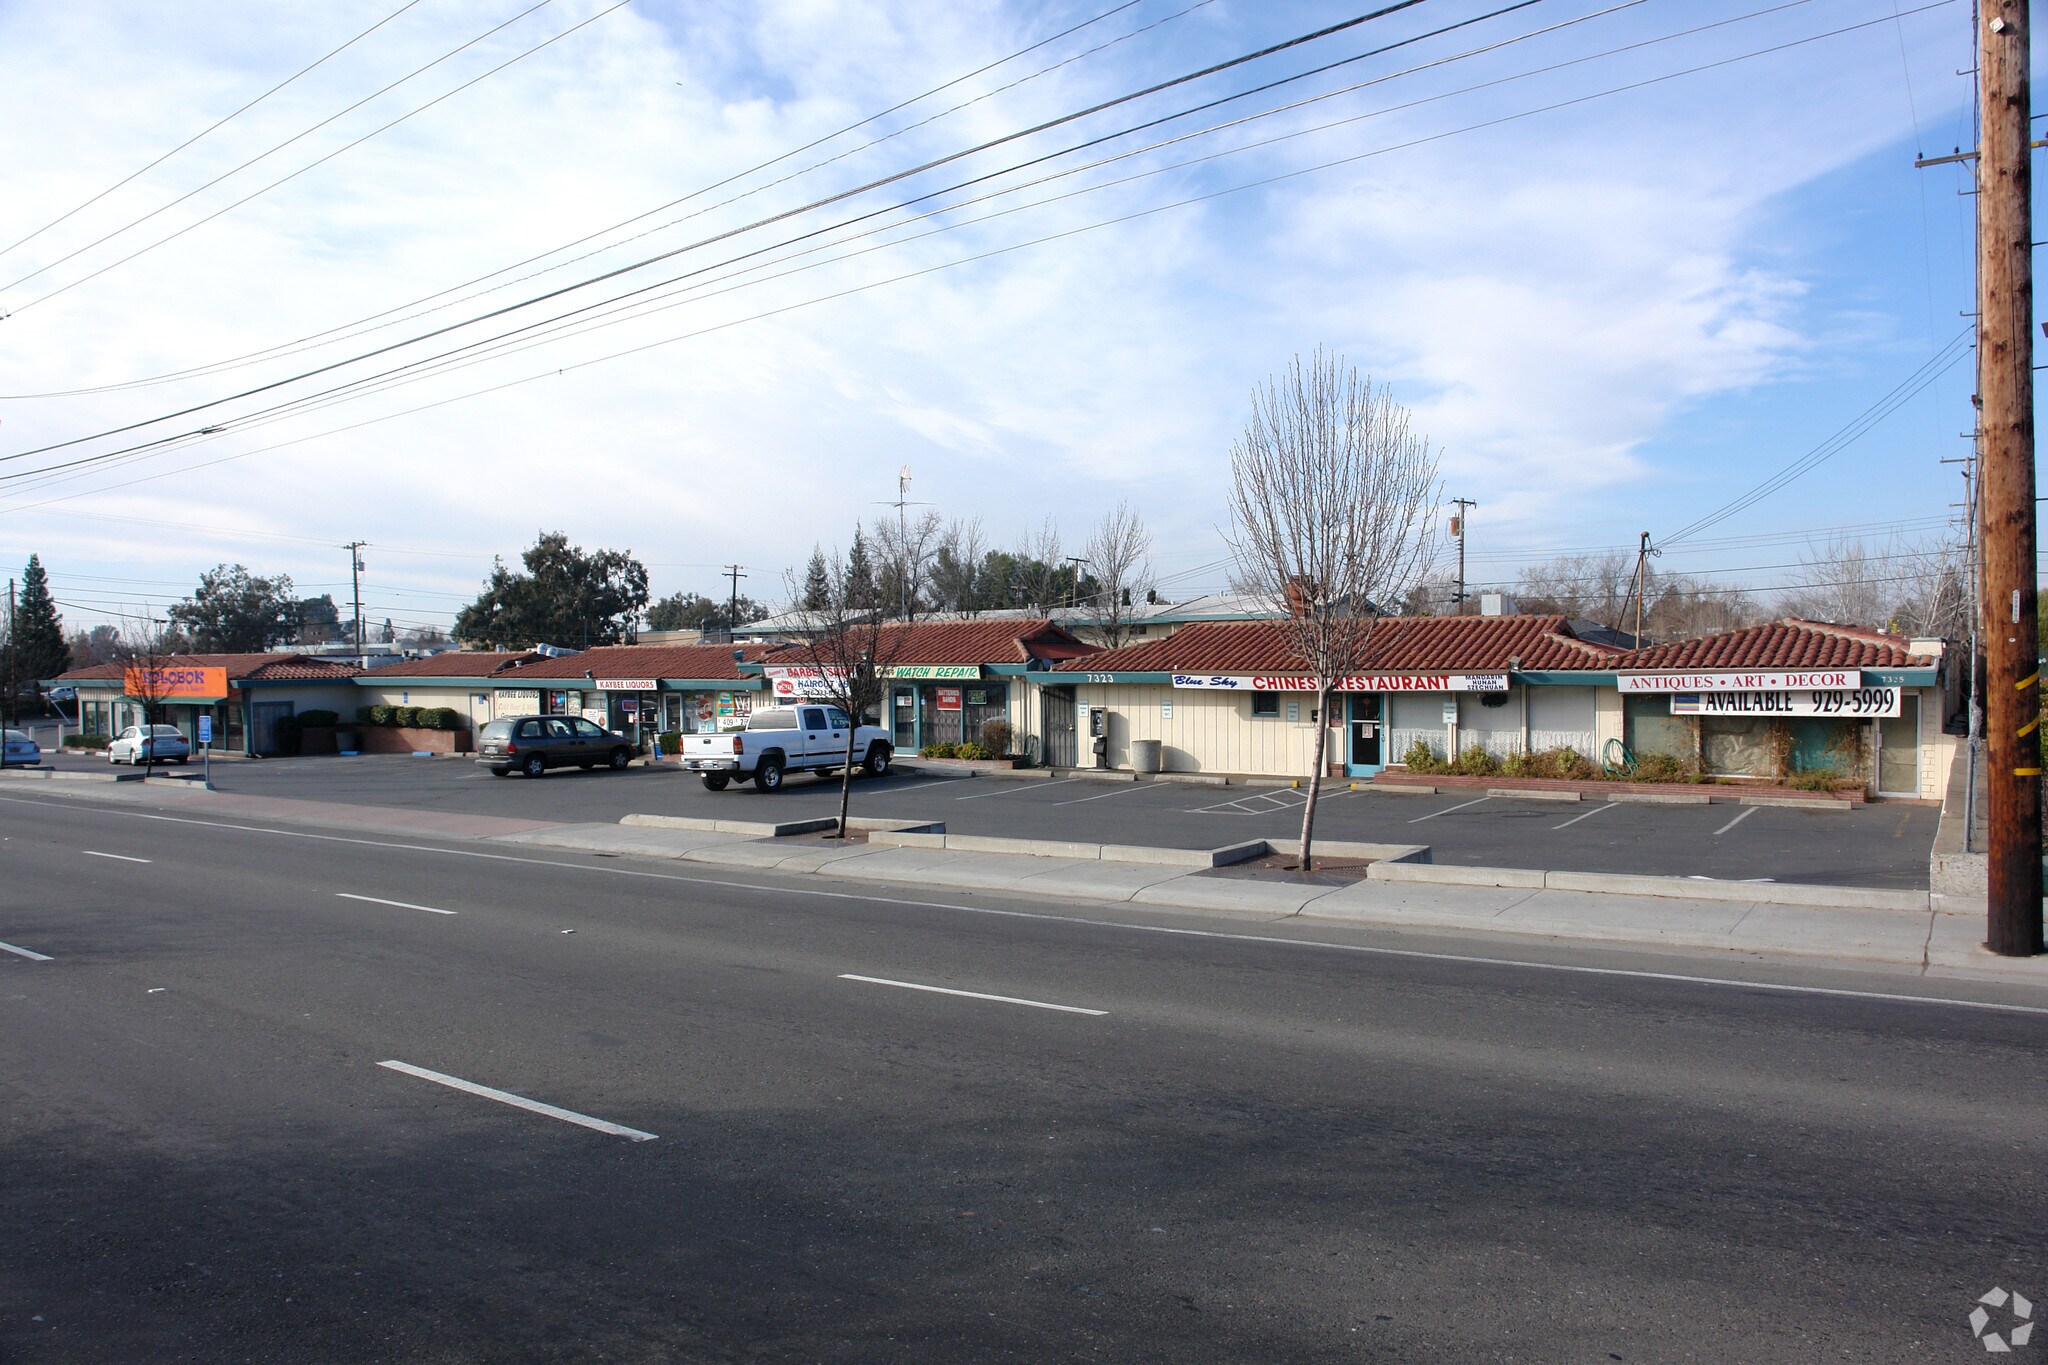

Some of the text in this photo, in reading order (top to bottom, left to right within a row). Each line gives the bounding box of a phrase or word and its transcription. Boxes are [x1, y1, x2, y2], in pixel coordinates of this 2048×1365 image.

[143, 671, 204, 684] KOLOBOK
[896, 667, 930, 677] WATCH
[936, 667, 977, 677] REPAIR
[1087, 674, 1114, 683] 7323
[1174, 676, 1238, 688] Blue Sky
[1253, 676, 1321, 689] CHINES
[1630, 673, 1846, 690] ANTIQUES ART DECOR
[600, 681, 654, 689] KAYBEE LIQUORS
[1705, 689, 1894, 713] AVAILABLE 929-5999
